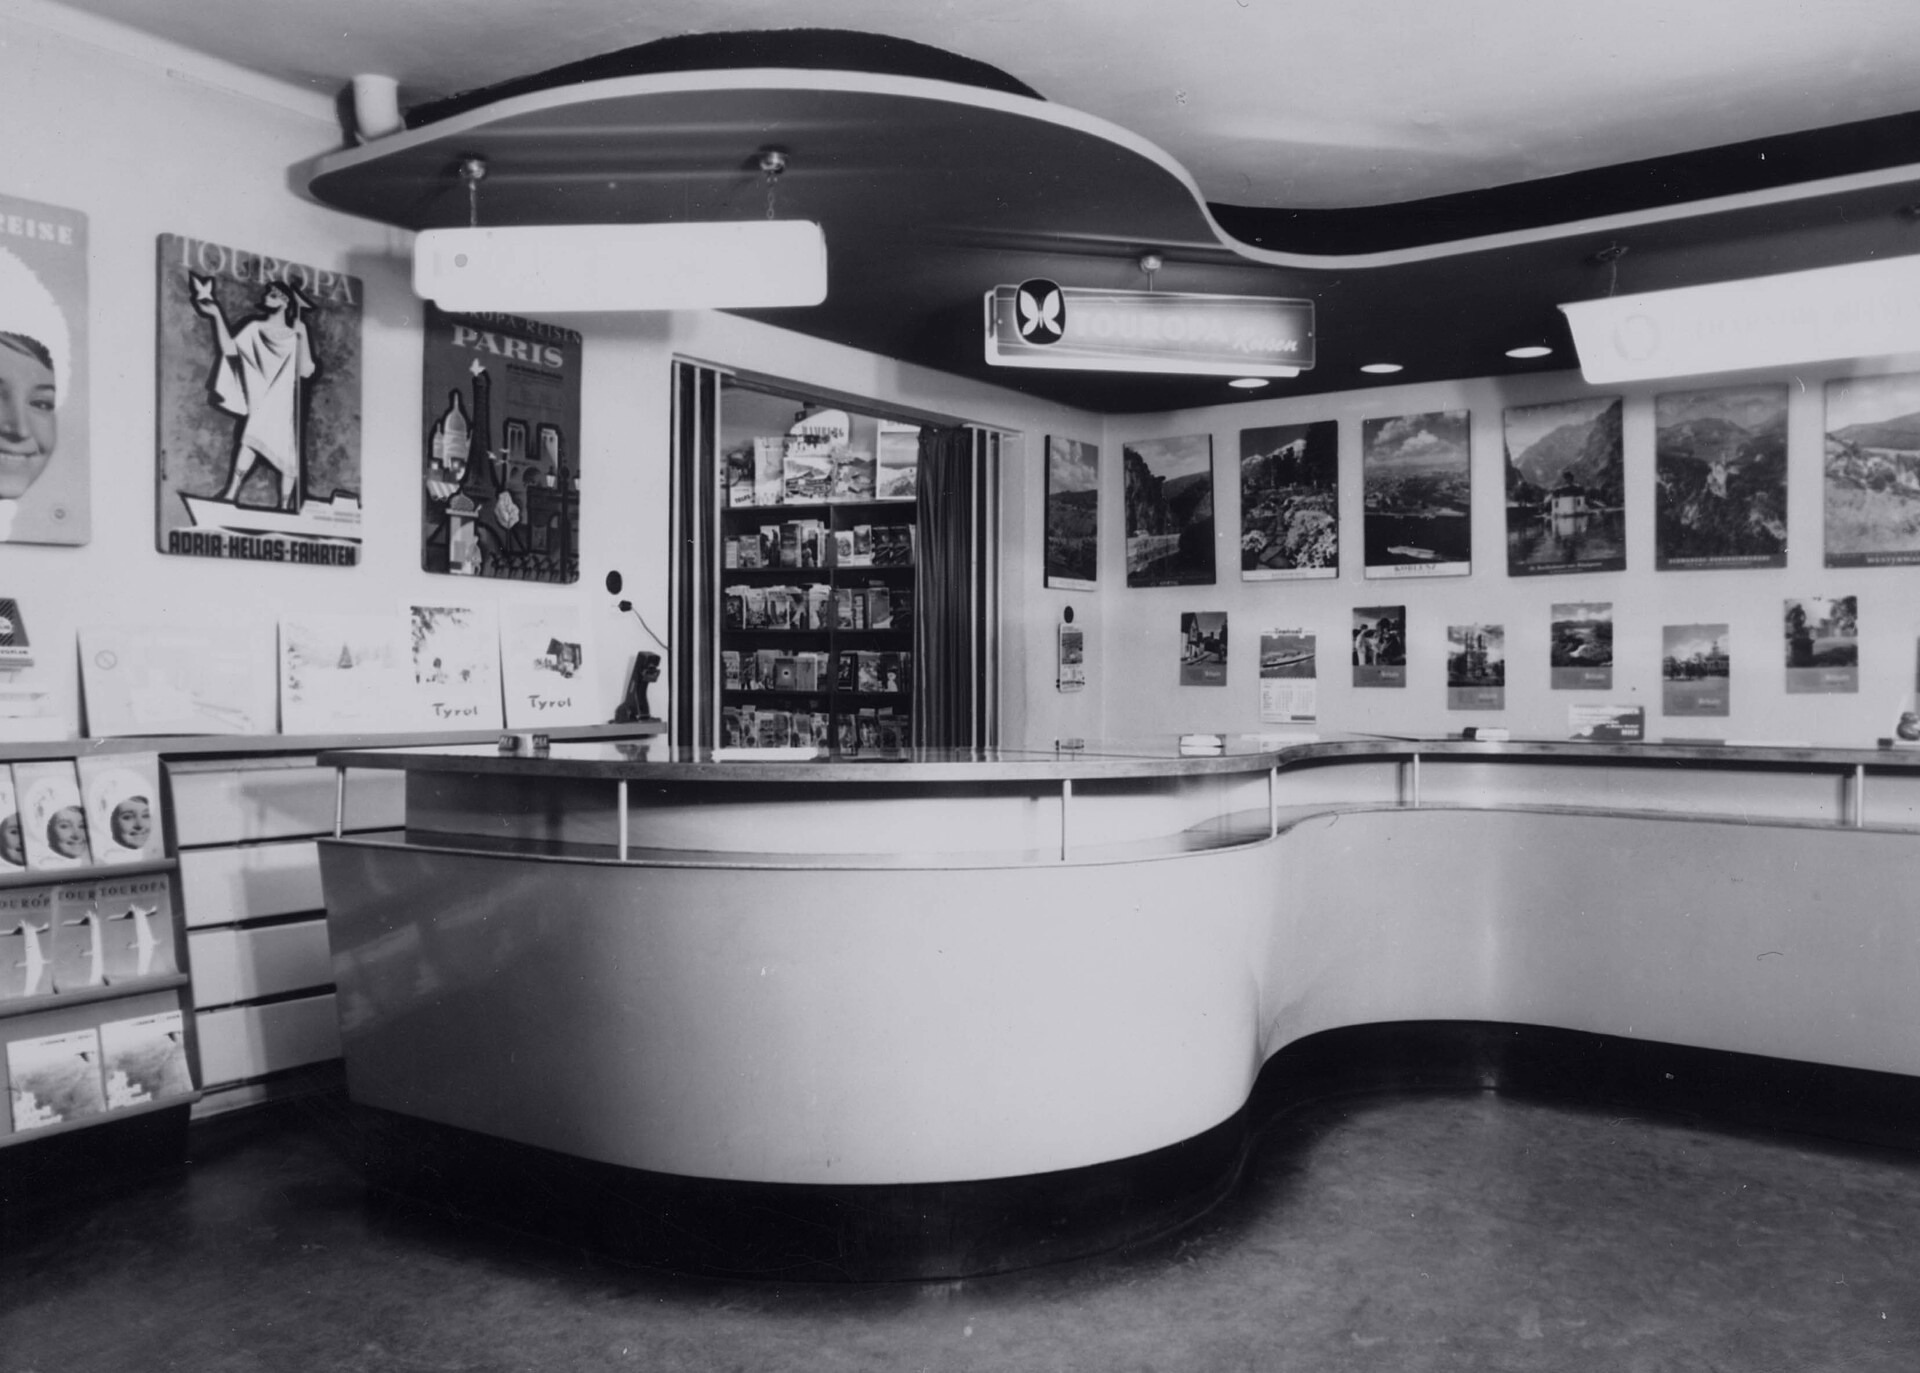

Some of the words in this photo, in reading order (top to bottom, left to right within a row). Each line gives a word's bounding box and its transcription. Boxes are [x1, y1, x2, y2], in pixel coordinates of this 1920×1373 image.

[173, 235, 357, 305] TOUROPA
[1073, 311, 1227, 342] TOUROPA
[1232, 326, 1298, 354] Reisen
[452, 323, 564, 369] PARIS
[432, 702, 478, 721] Tyrol
[528, 694, 572, 711] Tyrol
[58, 889, 96, 901] TOUR
[99, 881, 166, 897] TOUROPA
[0, 896, 51, 910] OUROP
